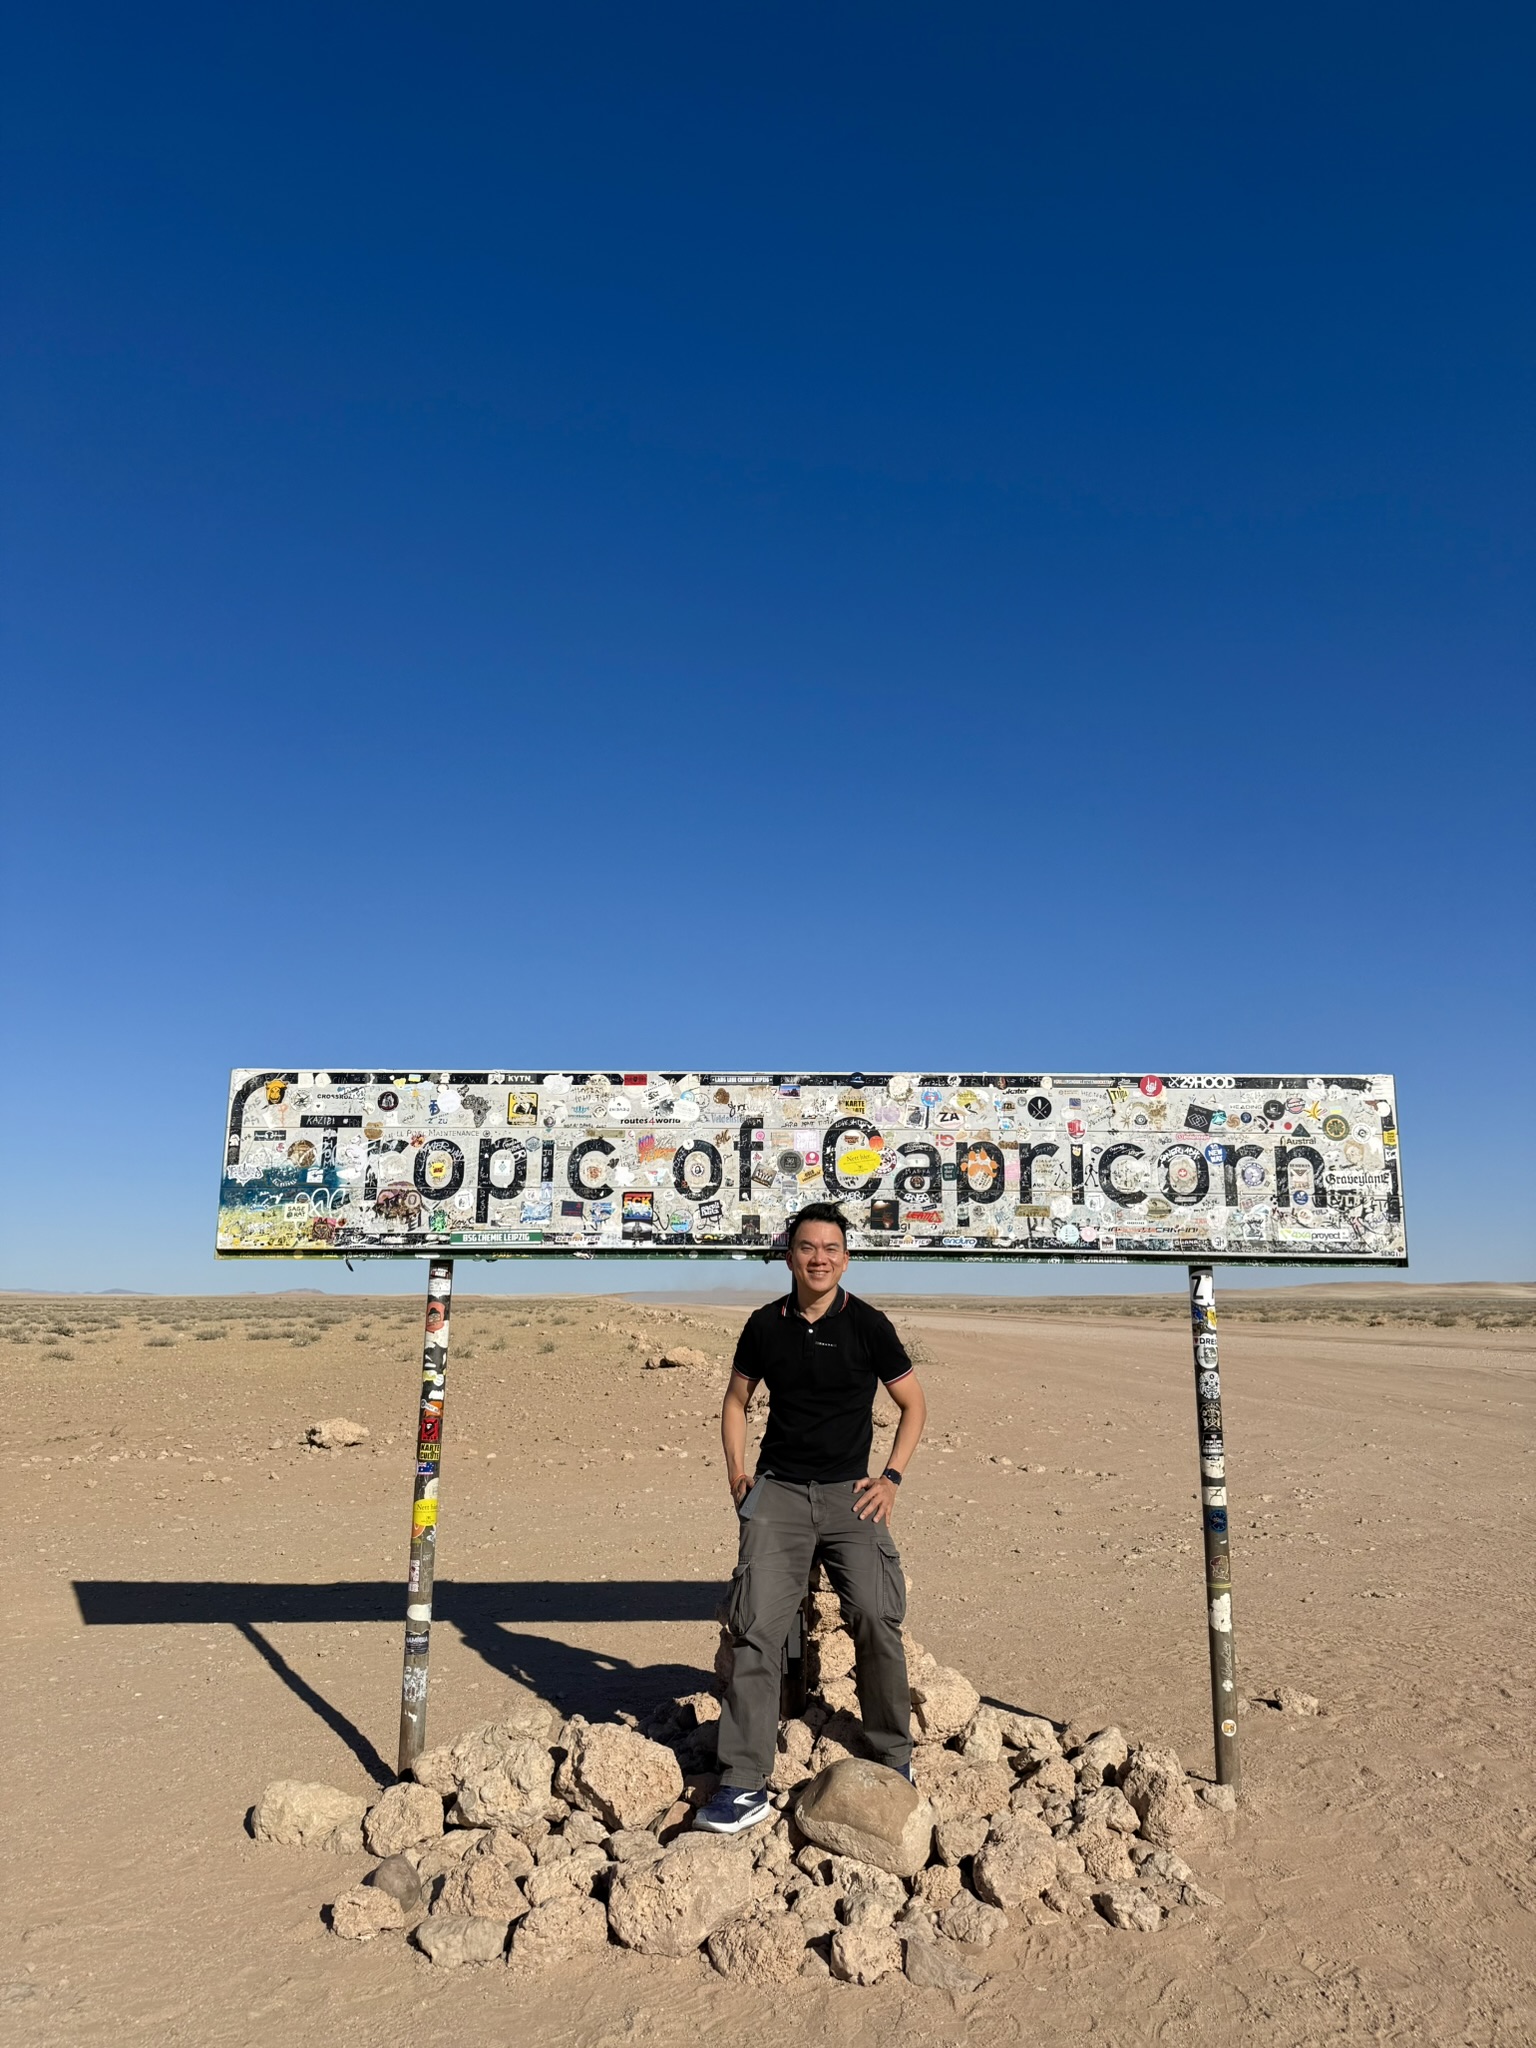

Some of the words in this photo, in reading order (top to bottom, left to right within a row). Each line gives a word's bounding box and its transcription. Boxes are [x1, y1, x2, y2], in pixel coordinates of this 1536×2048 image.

[939, 1112, 960, 1122] ZA
[673, 1117, 763, 1201] of
[822, 1116, 1328, 1228] Capricorn
[463, 1232, 476, 1241] BSG
[478, 1232, 502, 1241] CHEMIE
[504, 1232, 529, 1241] LEIPZIG
[420, 1443, 440, 1451] KARTE
